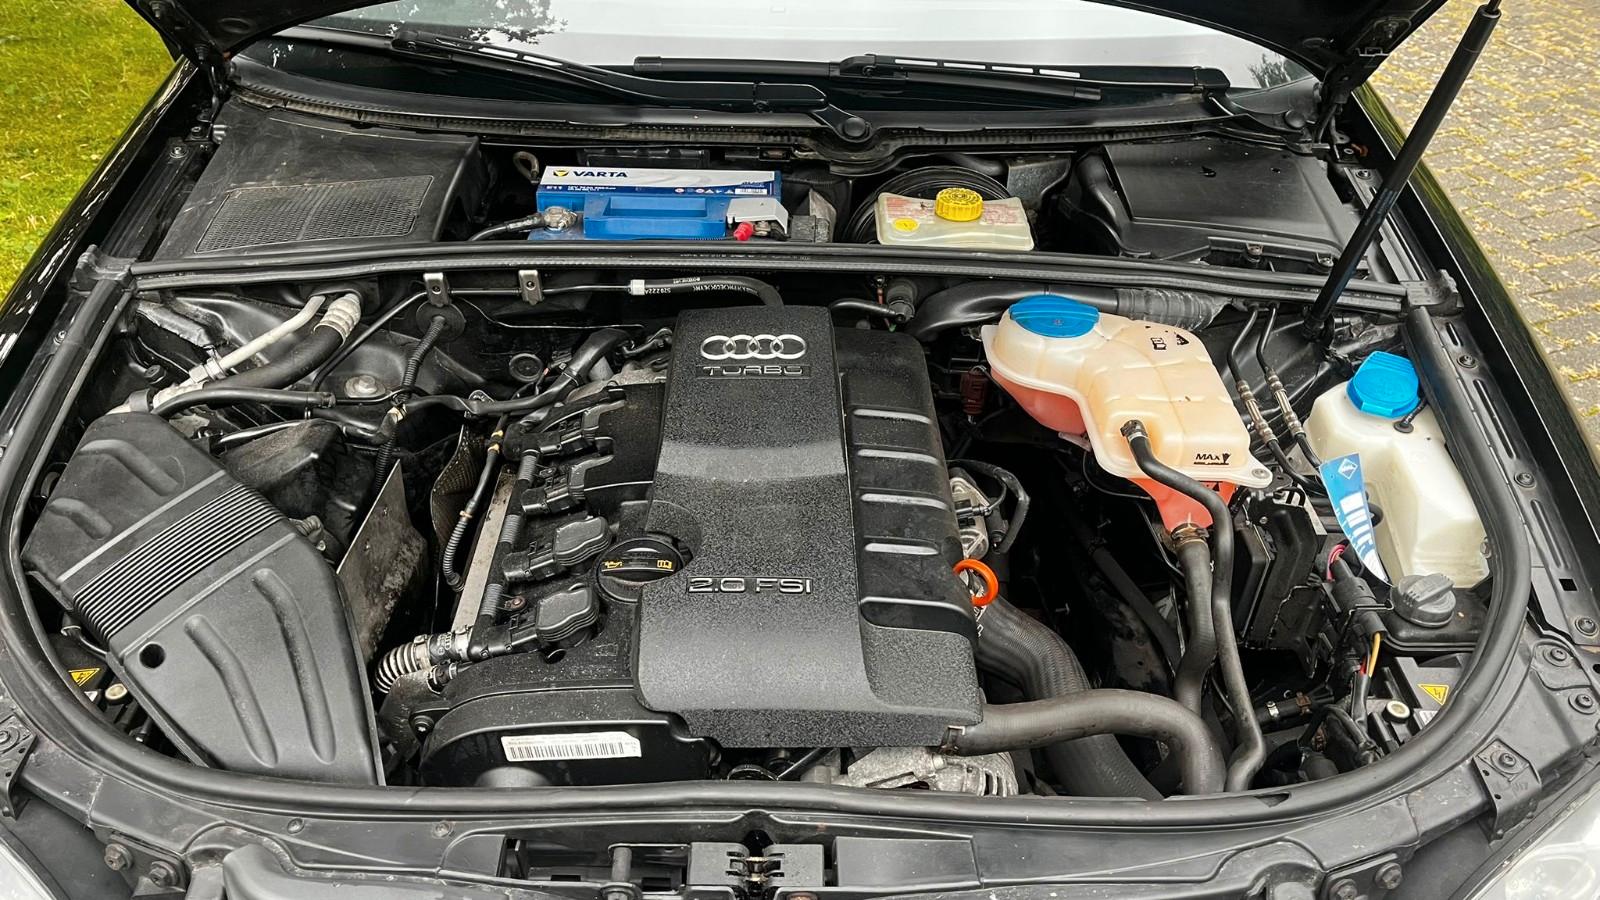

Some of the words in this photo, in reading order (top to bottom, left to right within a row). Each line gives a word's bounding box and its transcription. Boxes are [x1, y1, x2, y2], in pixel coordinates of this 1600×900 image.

[702, 365, 803, 376] TURBO
[688, 577, 746, 593] 2.0
[755, 577, 812, 593] FSI
